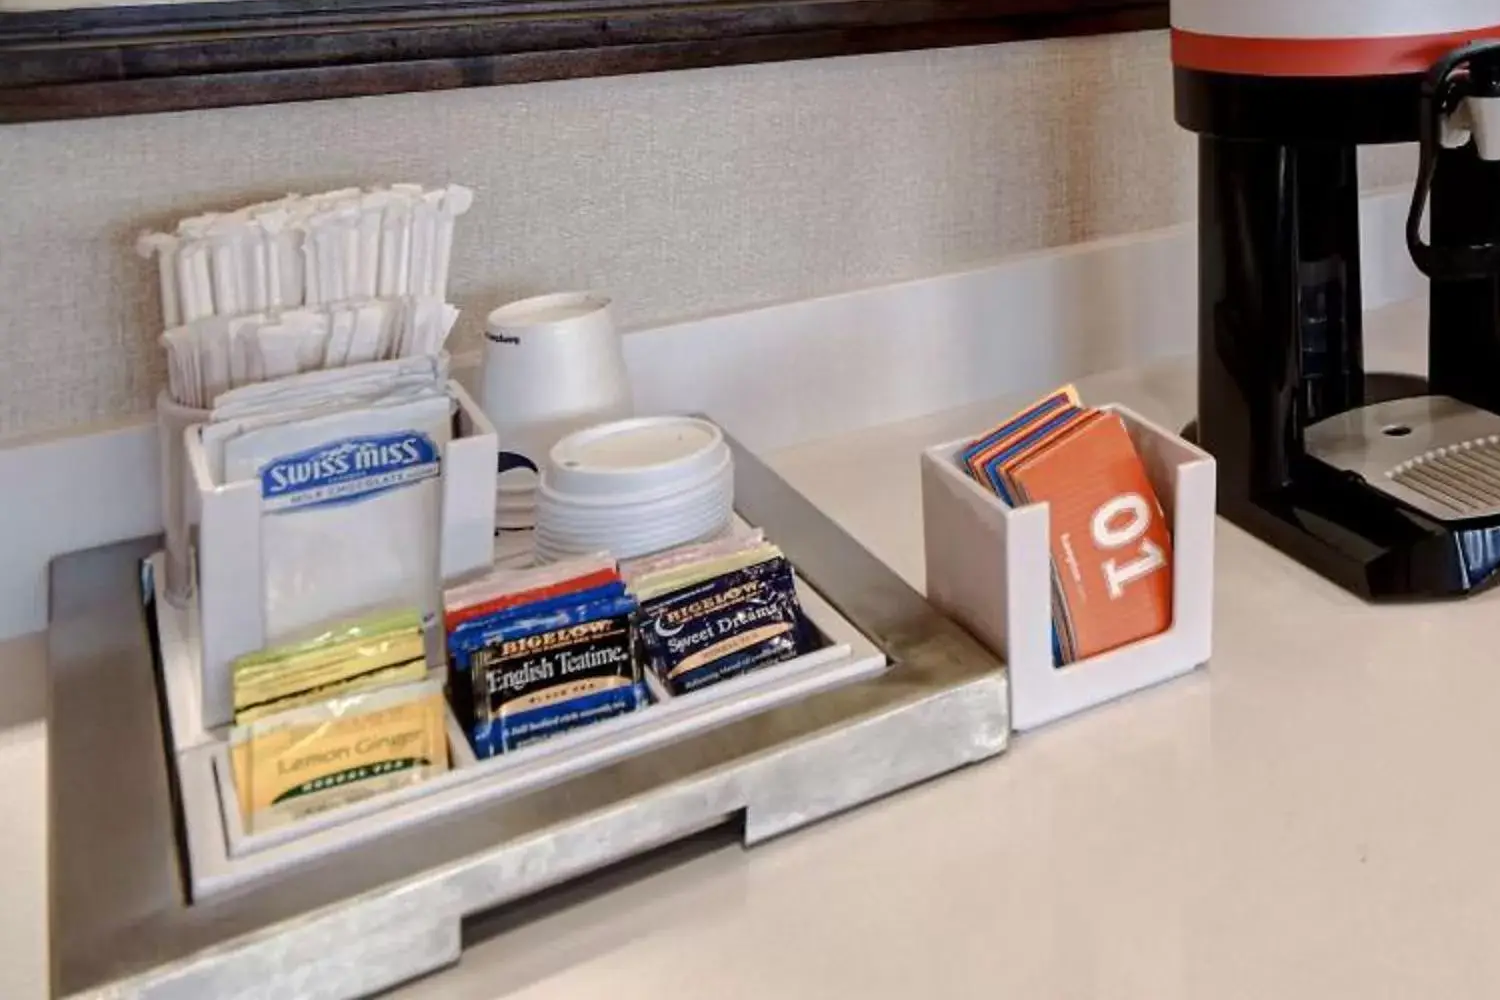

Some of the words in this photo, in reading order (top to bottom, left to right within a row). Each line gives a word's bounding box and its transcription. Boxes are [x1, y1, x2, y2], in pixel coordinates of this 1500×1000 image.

[269, 452, 349, 492] SWISS
[356, 437, 417, 470] MISS
[666, 580, 761, 622] BIGELOW
[502, 619, 612, 655] BIGELOW
[668, 620, 714, 654] Sweet
[717, 602, 782, 634] Dreams
[486, 658, 554, 693] English
[278, 747, 350, 775] Lemon
[354, 729, 425, 757] Ginger
